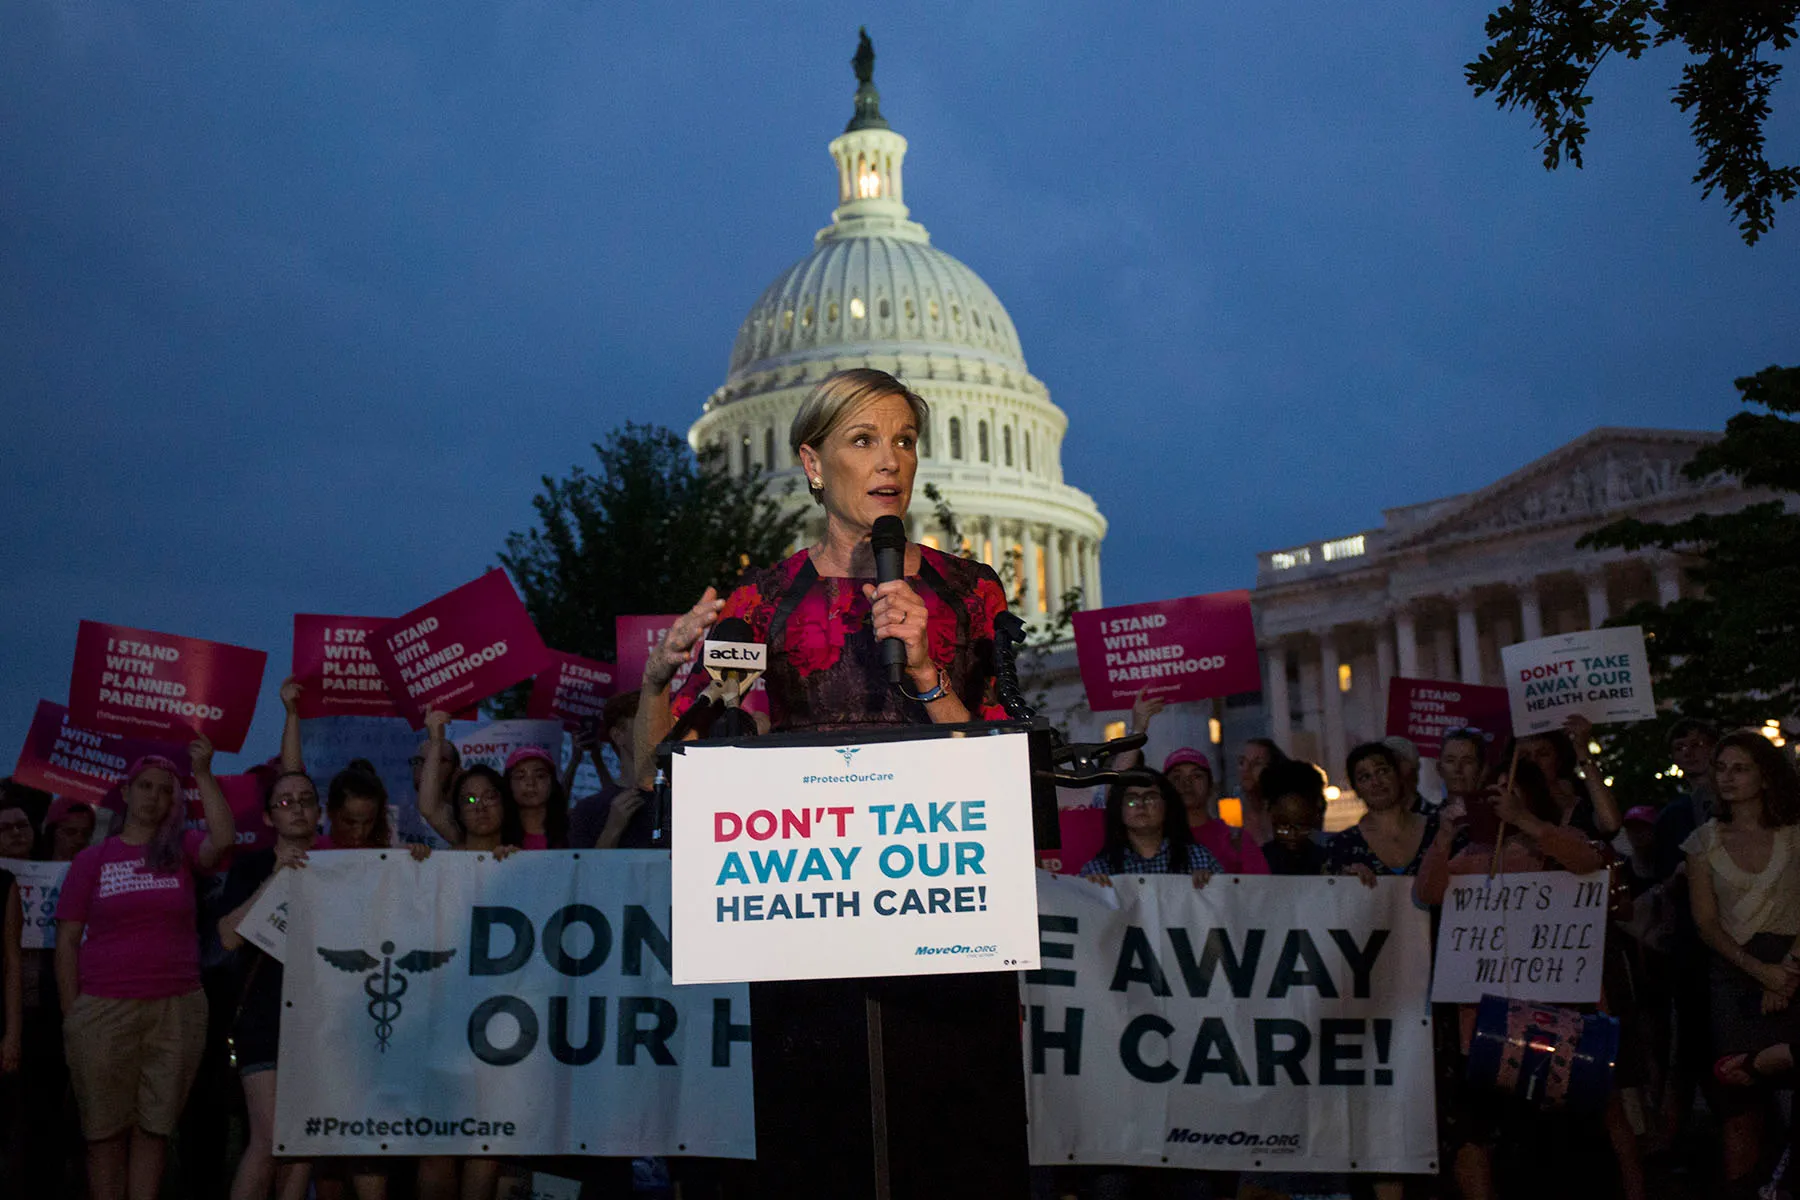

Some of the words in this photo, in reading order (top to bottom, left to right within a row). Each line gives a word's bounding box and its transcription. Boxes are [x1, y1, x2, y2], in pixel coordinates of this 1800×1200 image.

[324, 628, 330, 642] I
[335, 628, 366, 643] STA
[386, 637, 395, 652] I
[393, 616, 439, 649] STAND
[1100, 621, 1107, 635] I
[1110, 614, 1167, 634] STAND
[107, 637, 114, 653] I
[118, 639, 179, 662] STAND
[394, 639, 430, 667] WITH
[710, 647, 760, 661] act.tv
[1103, 633, 1149, 651] WITH
[106, 655, 154, 676] WITH
[400, 642, 465, 683] PLANNED
[1105, 644, 1184, 667] PLANNED
[323, 662, 381, 676] PLANN
[406, 640, 508, 699] PARENTHOOD
[569, 664, 612, 684] STAND
[1108, 655, 1226, 683] PARENTHOOD
[1520, 660, 1575, 683] DON'T
[1581, 654, 1630, 671] TAKE
[102, 672, 186, 698] PLANNED
[559, 674, 595, 692] WITH
[1418, 688, 1462, 703] STAND
[1525, 675, 1579, 697] AWAY
[1587, 671, 1631, 686] OUR
[99, 688, 224, 721] PARENTHOOD
[1409, 699, 1446, 713] WITH
[1526, 692, 1583, 712] HEALTH
[1588, 687, 1634, 702] CARE!
[60, 726, 103, 748] WITH
[463, 743, 508, 754] DON'T
[53, 738, 127, 769] PLANNED
[802, 773, 894, 784] #ProtectOurCare
[713, 807, 854, 843] DON'T
[868, 800, 987, 836] TAKE
[715, 846, 862, 886] AWAY
[878, 841, 986, 880] OUR
[716, 891, 860, 922] HEALTH
[873, 886, 987, 916] CARE!
[1453, 881, 1552, 912] WHAT'S
[1573, 882, 1604, 908] IN
[915, 944, 997, 955] MoveOn.ORG
[1451, 926, 1505, 951] THE
[1531, 923, 1593, 950] BILL
[1109, 926, 1391, 998] AWAY
[467, 995, 678, 1067] OUR
[1119, 1014, 1393, 1086] CARE!
[306, 1117, 516, 1136] #ProtectOurCare
[1166, 1127, 1300, 1147] MoveOn.ORG
